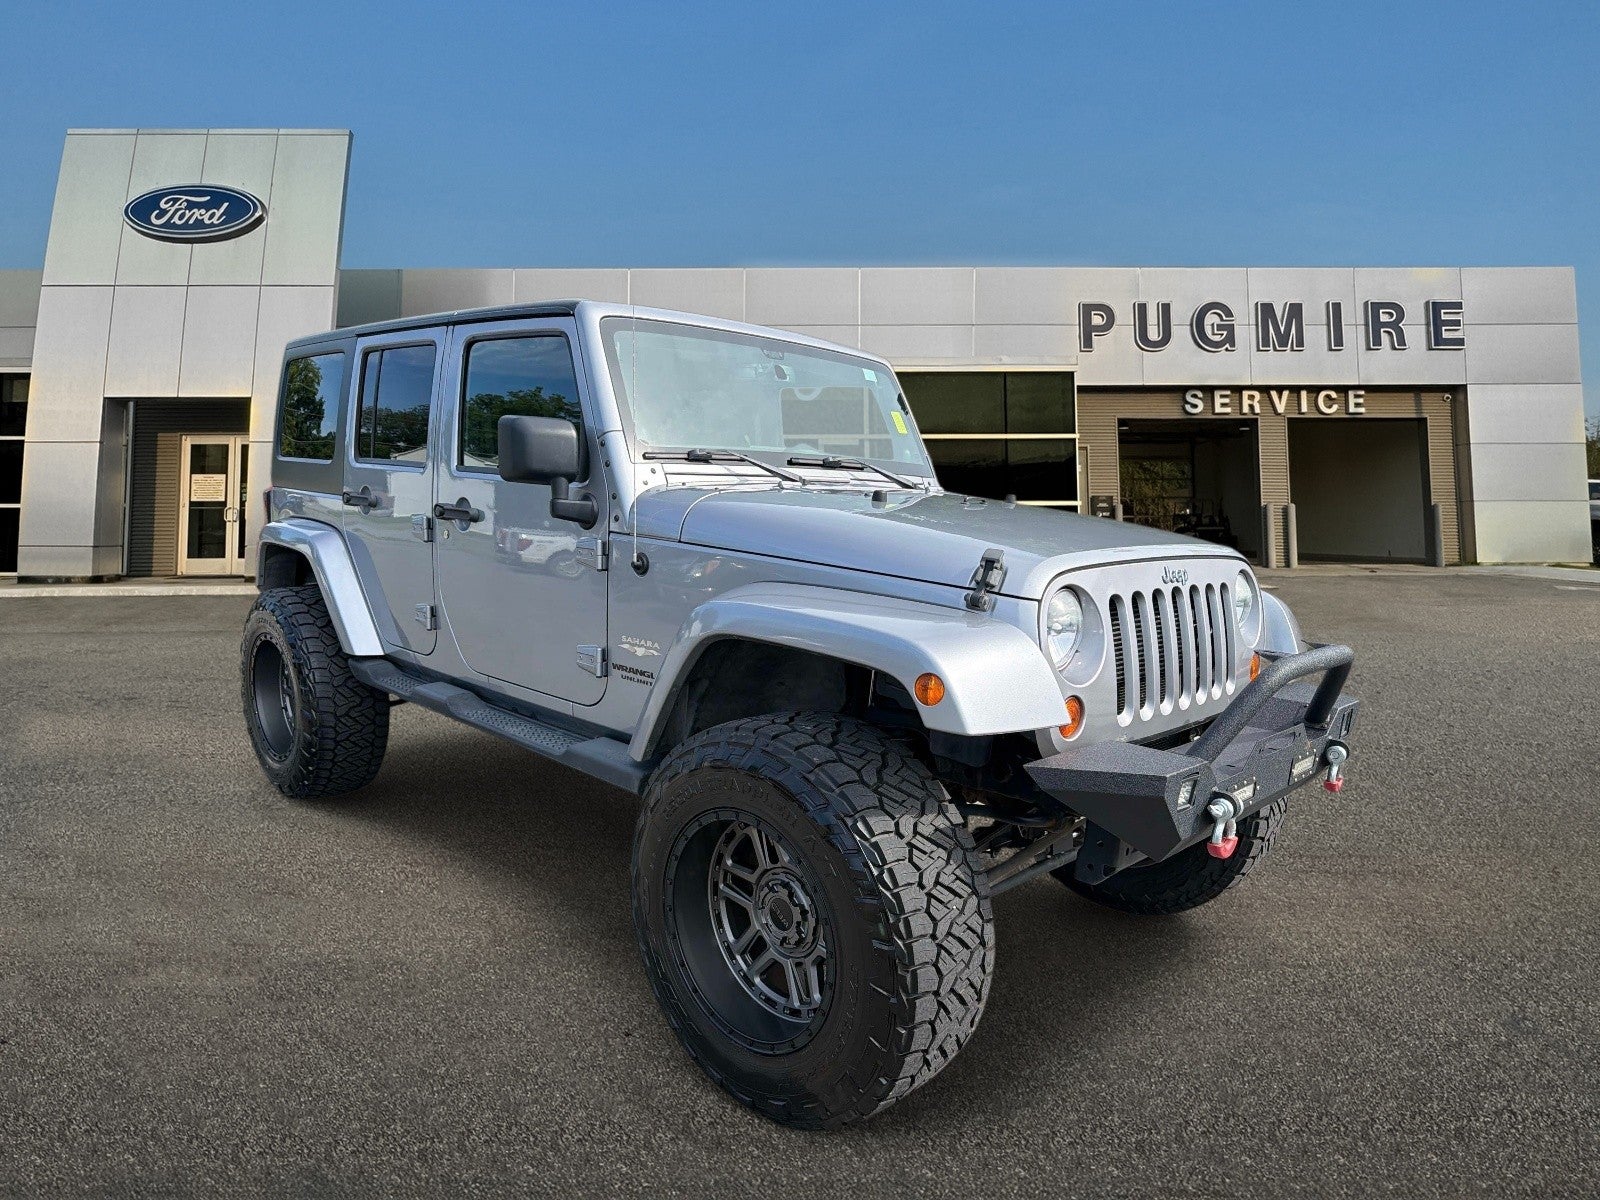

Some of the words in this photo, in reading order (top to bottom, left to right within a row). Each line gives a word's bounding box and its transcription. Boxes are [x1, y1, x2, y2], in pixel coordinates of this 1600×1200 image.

[150, 195, 230, 225] Ford
[1078, 299, 1467, 353] PUGMIRE
[1182, 389, 1366, 415] SERVICE
[1161, 565, 1189, 587] Jeep
[621, 635, 661, 649] SAHARA
